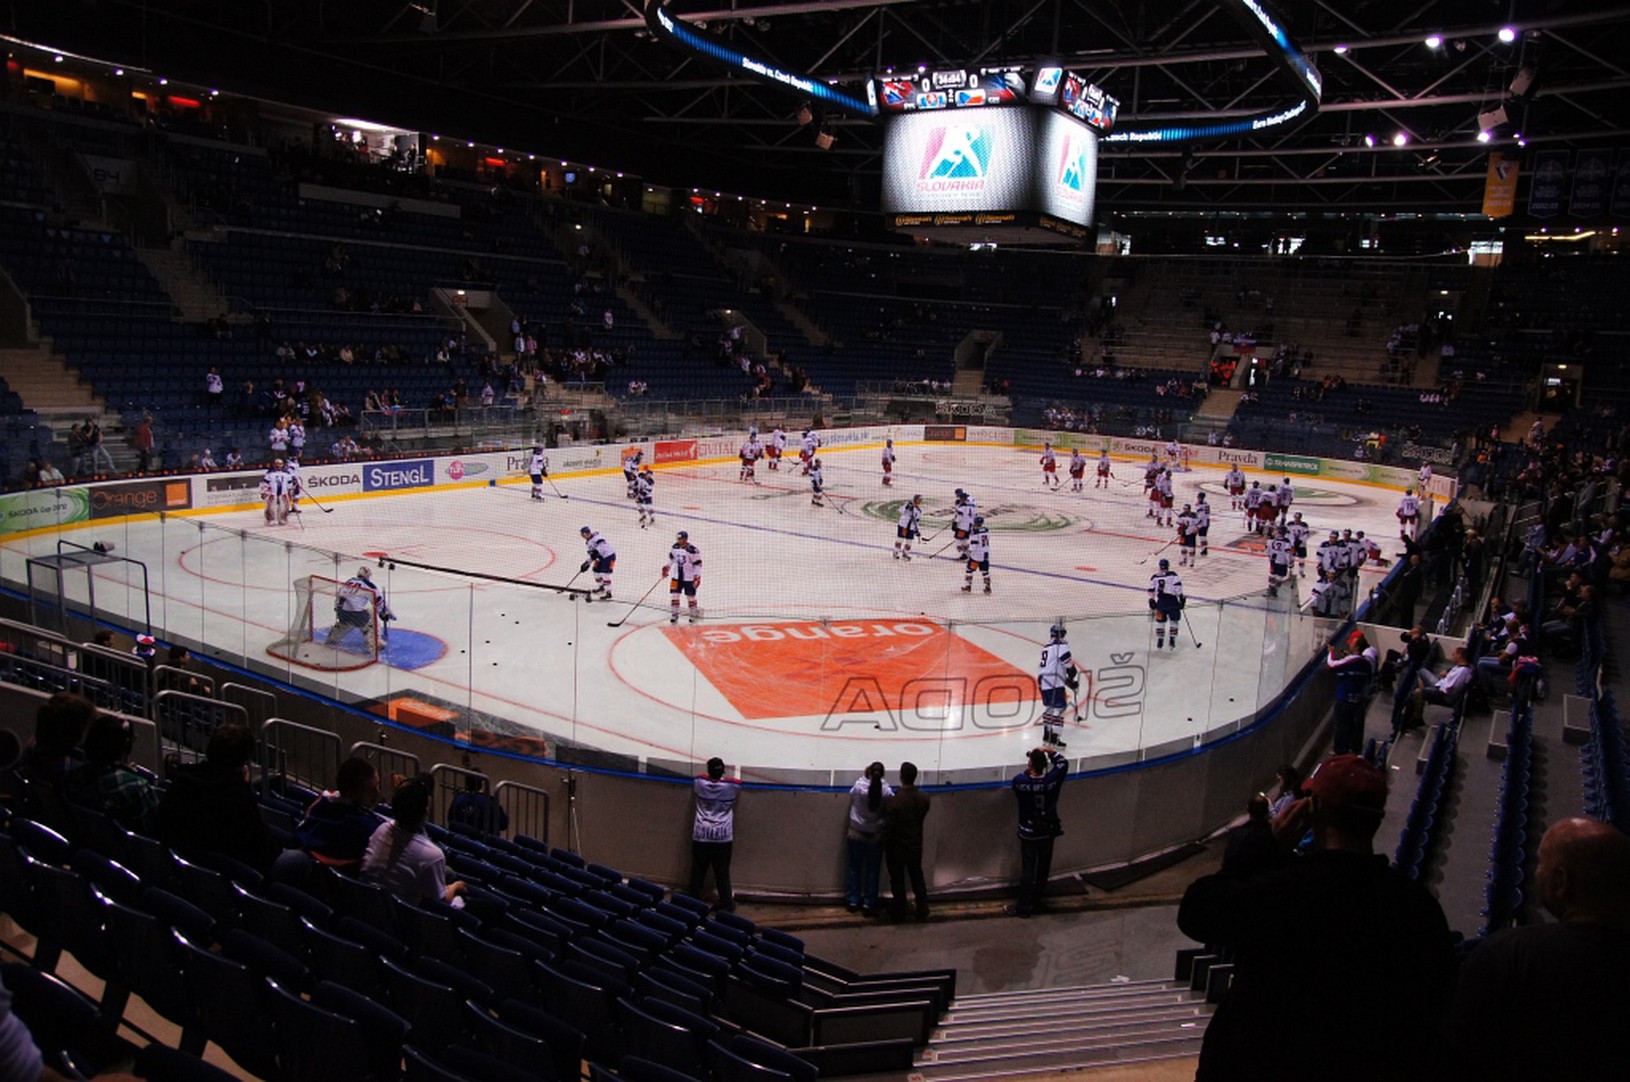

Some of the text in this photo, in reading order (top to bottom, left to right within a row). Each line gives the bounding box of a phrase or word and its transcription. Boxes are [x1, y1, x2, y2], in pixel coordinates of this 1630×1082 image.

[1218, 450, 1257, 464] Pravda
[308, 474, 361, 489] ŠKODA
[371, 464, 430, 487] STENGL
[92, 489, 158, 510] Orange
[702, 621, 934, 643] orange
